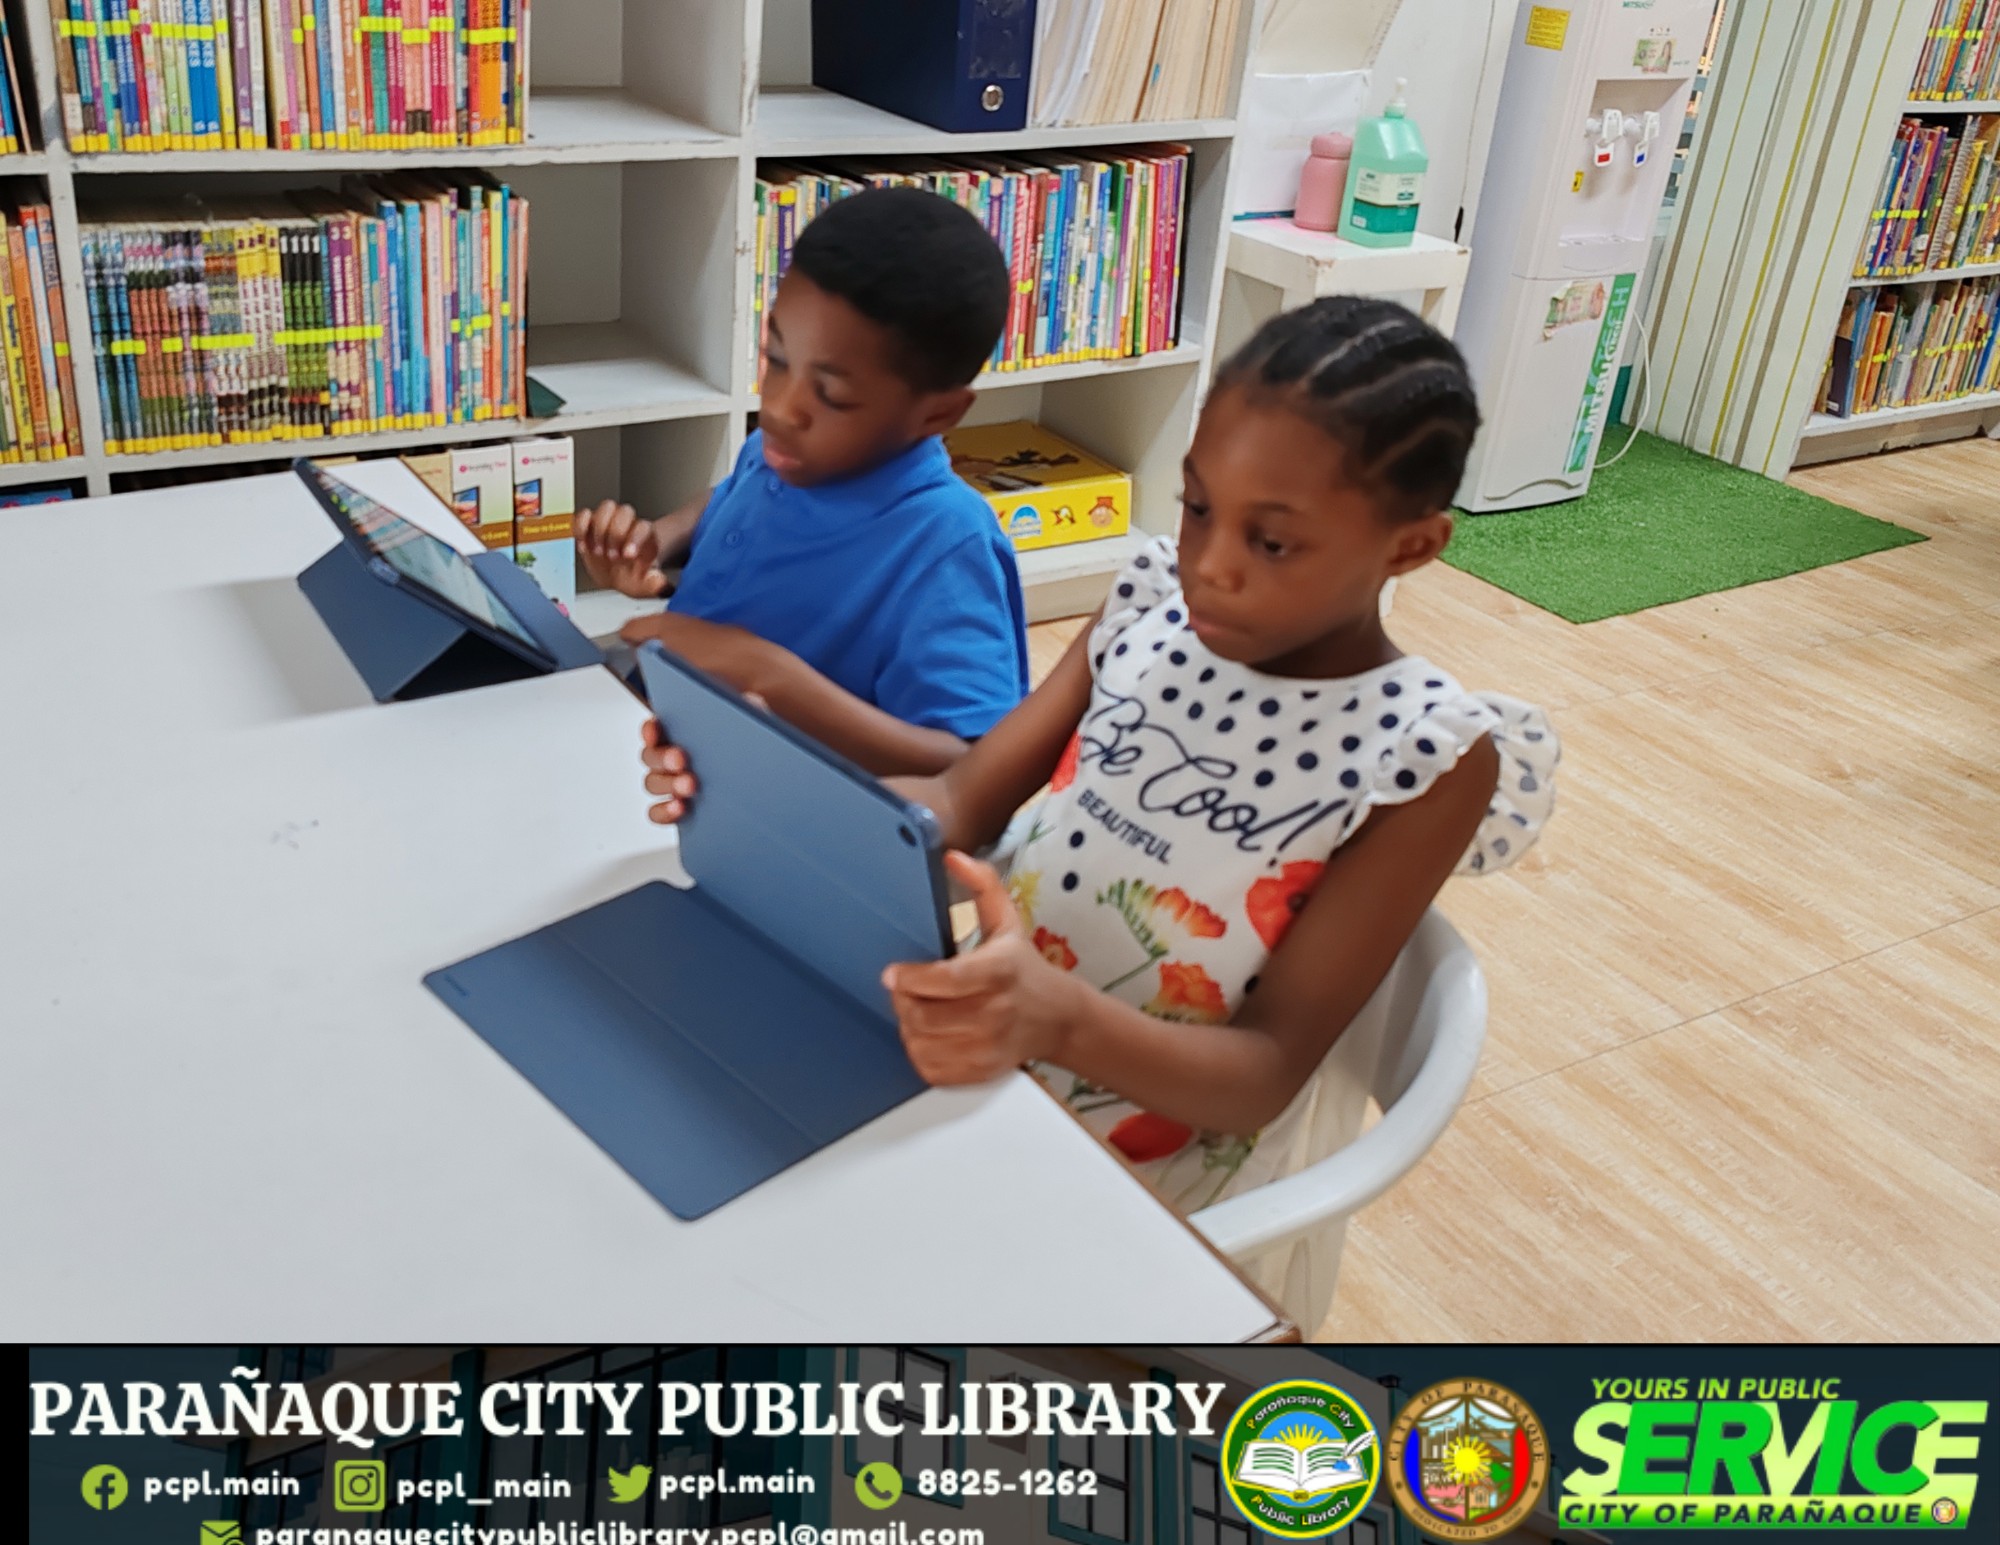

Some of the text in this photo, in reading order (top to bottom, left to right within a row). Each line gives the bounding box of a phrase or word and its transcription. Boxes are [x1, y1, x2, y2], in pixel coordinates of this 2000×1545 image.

[331, 226, 340, 241] 3
[342, 225, 352, 240] 3
[280, 235, 288, 254] 1
[290, 235, 299, 254] 1
[301, 235, 310, 254] 1
[311, 235, 320, 254] 1
[1076, 789, 1173, 864] BEAUTIFUL
